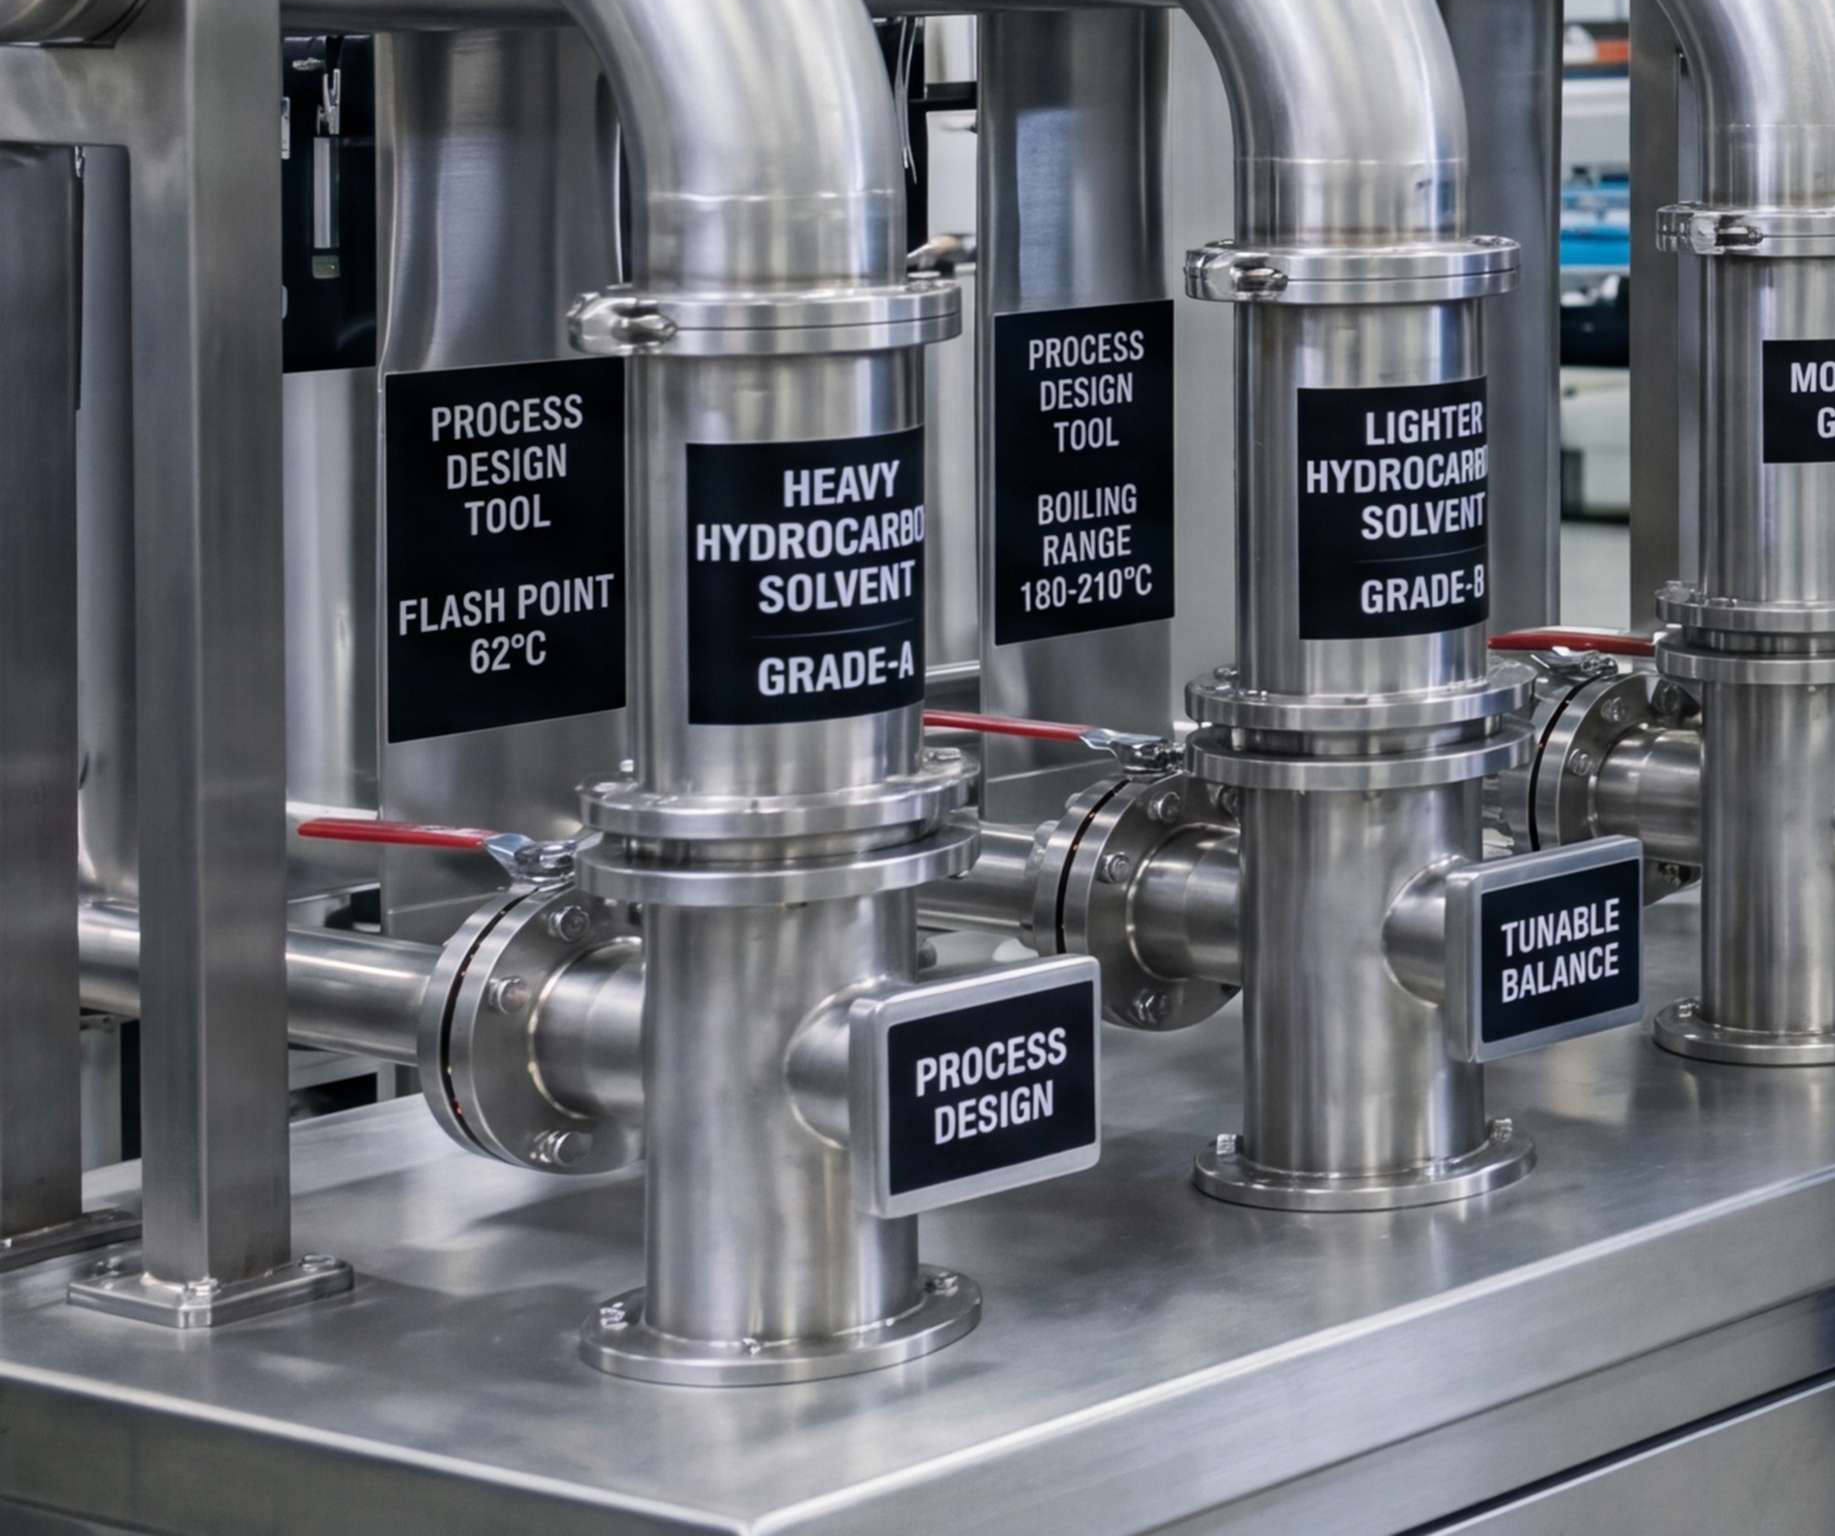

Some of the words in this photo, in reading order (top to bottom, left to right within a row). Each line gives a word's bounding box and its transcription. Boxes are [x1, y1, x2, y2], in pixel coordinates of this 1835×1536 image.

[1028, 330, 1144, 371] PROCESS
[1040, 372, 1133, 412] DESIGN
[431, 394, 583, 442] PROCESS
[1053, 416, 1119, 452] TOOL
[1365, 401, 1483, 446] LIGHTER
[446, 443, 567, 490] DESIGN
[784, 460, 900, 507] HEAVY
[464, 494, 551, 536] TOOL
[1038, 483, 1137, 526] BOILING
[1361, 492, 1486, 540] SOLVENT
[1042, 524, 1132, 567] RANGE
[399, 587, 505, 636] FLASH
[518, 573, 614, 620] POINT
[758, 560, 915, 614] SOLVENT
[1020, 564, 1152, 612] 180-210°C
[470, 630, 547, 674] 62°C
[758, 640, 915, 696] GRADE-A
[1501, 897, 1620, 957] TUNABLE
[1502, 942, 1620, 1003] BALANCE
[916, 1026, 1067, 1097] PROCESS
[934, 1080, 1054, 1146] DESIGN
